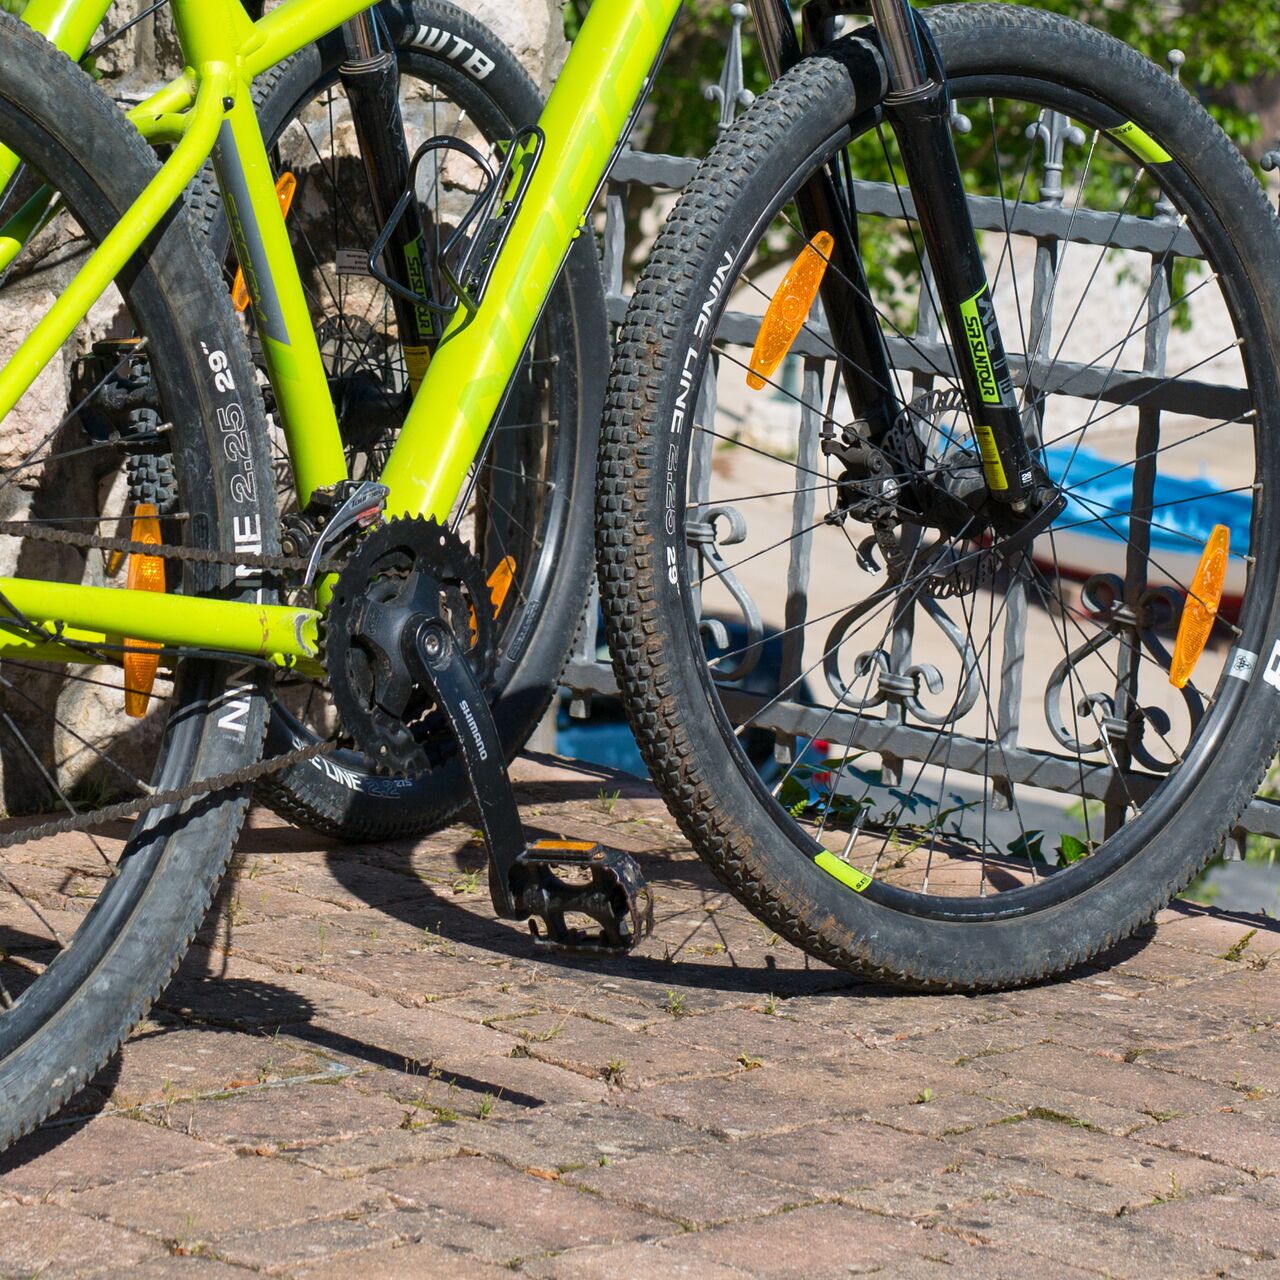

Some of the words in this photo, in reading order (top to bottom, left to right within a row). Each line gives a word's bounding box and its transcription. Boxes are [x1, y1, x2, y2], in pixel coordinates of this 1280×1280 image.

[410, 24, 496, 81] WTB
[693, 250, 734, 339] NINE
[670, 346, 699, 434] LINE
[216, 402, 257, 504] 2.25
[458, 699, 488, 762] SHIMANO
[324, 762, 365, 793] LINE
